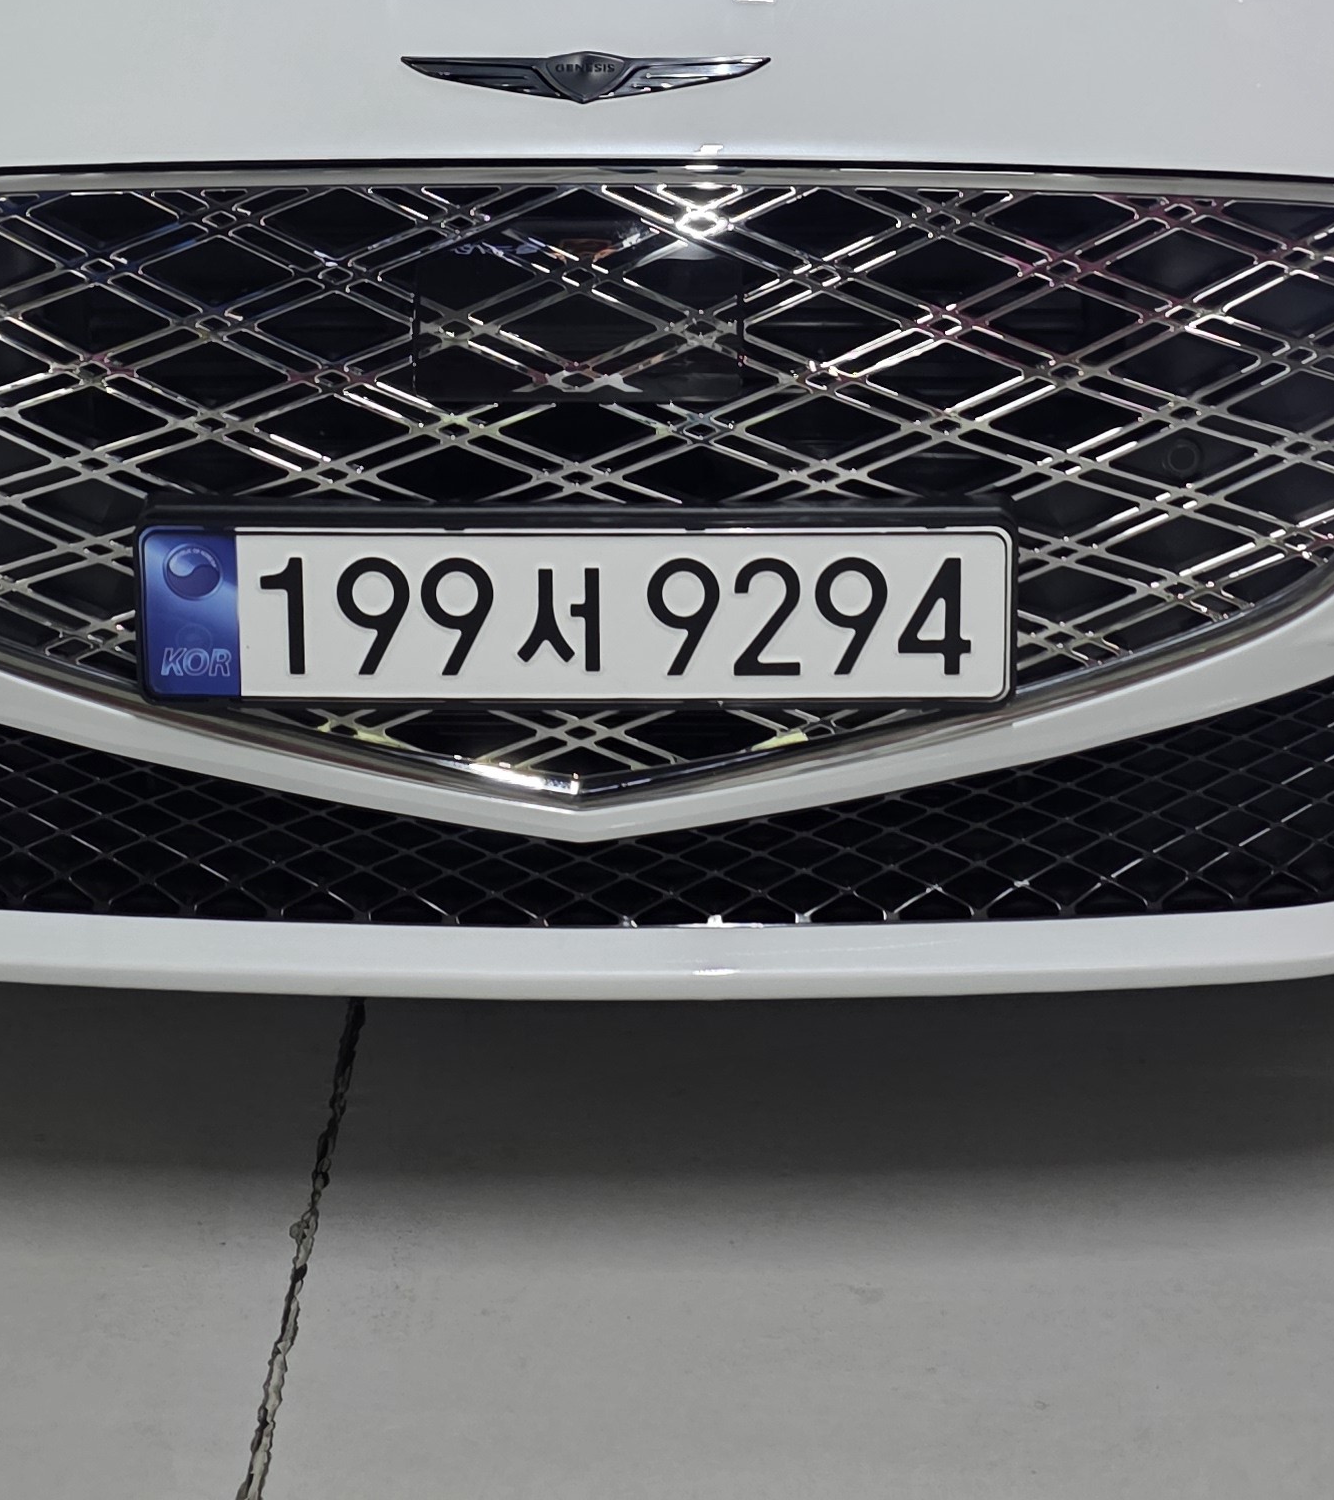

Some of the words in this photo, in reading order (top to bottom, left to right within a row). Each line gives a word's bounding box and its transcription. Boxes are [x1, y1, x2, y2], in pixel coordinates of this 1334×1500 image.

[555, 63, 616, 73] GENESIS
[259, 556, 601, 676] 199서
[646, 556, 972, 677] 9294
[160, 647, 232, 677] KOR
